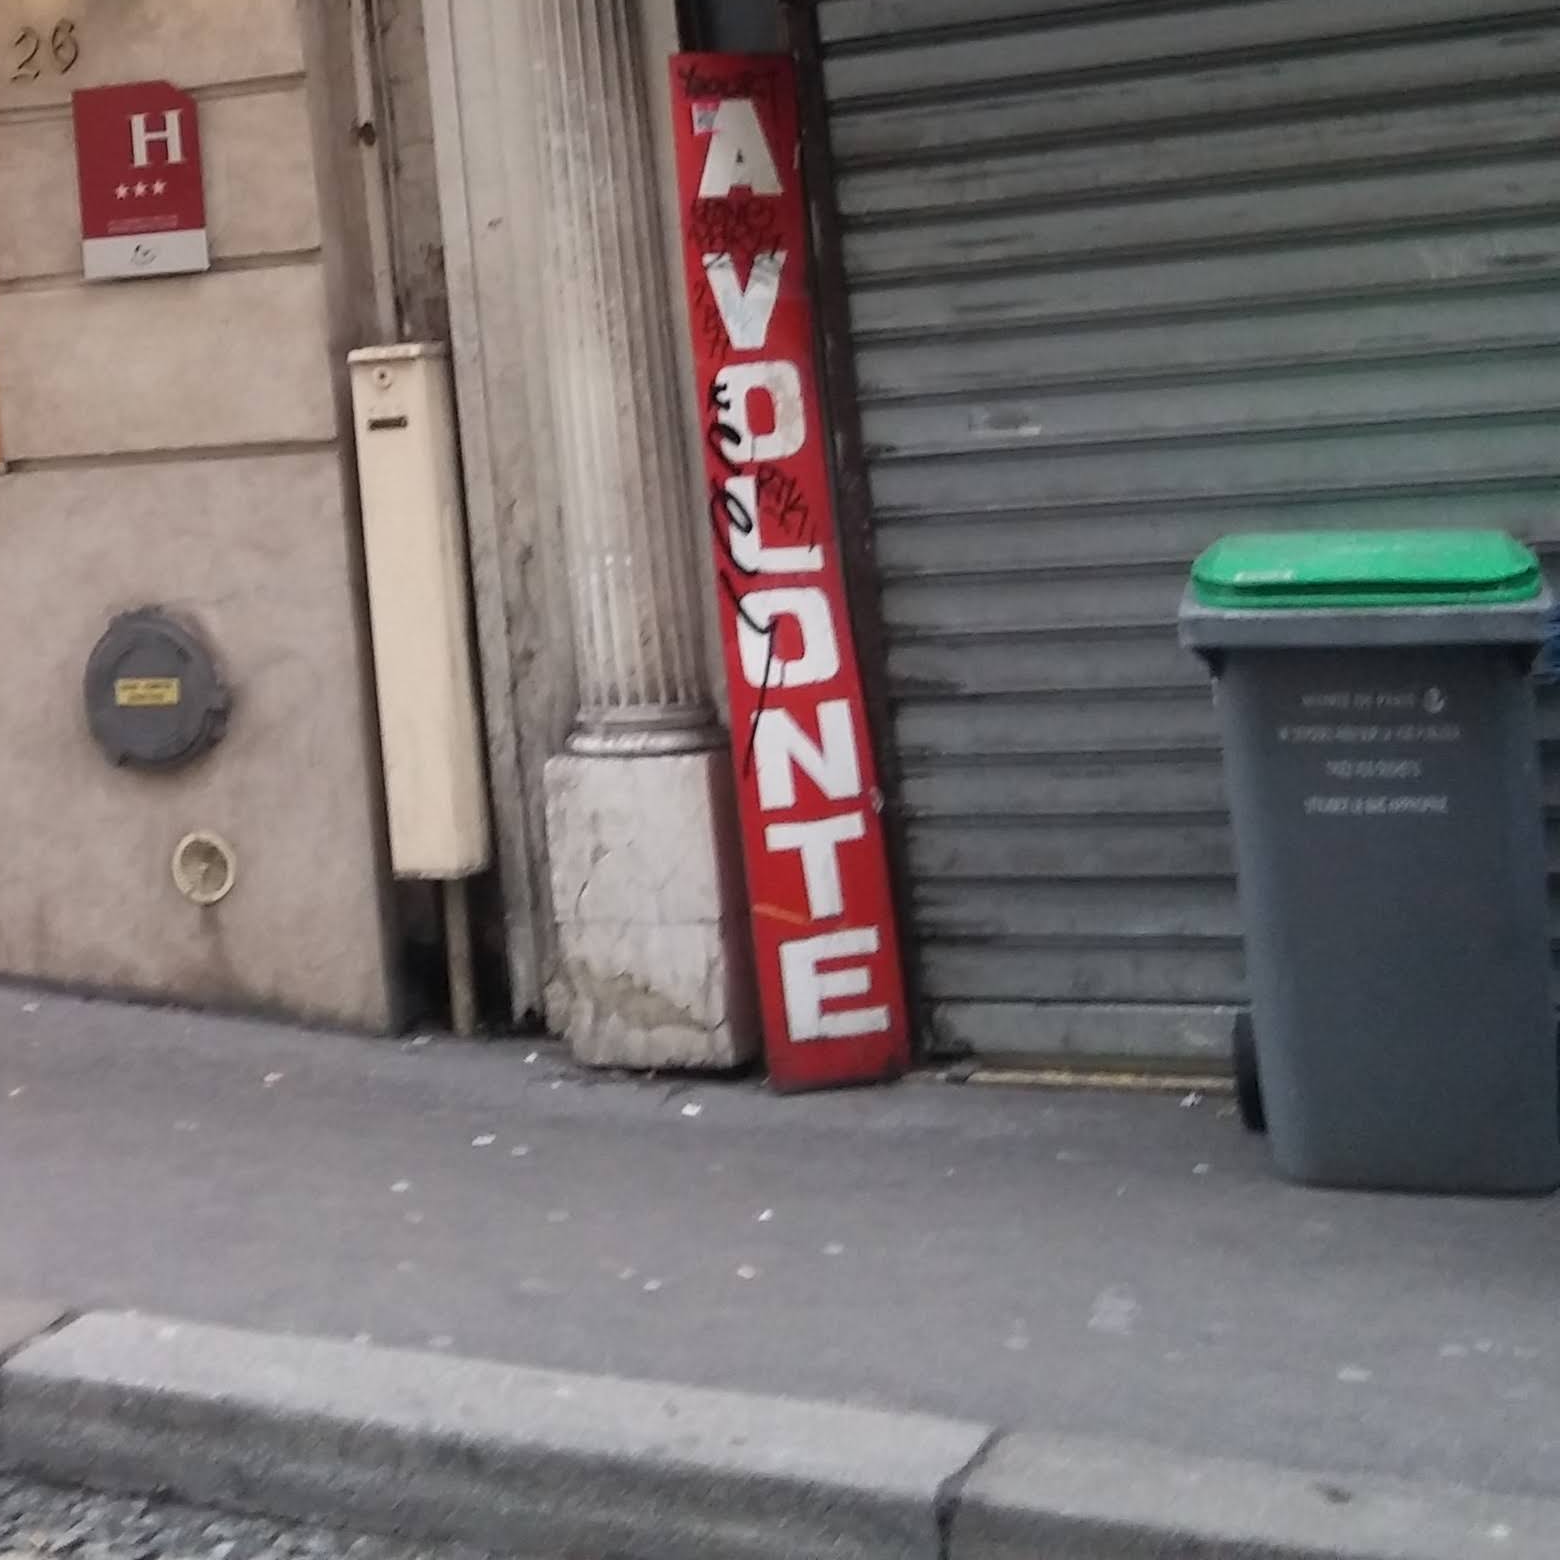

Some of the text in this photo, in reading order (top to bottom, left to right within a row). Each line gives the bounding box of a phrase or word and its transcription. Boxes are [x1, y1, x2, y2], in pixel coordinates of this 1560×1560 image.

[10, 17, 80, 84] 26
[126, 107, 187, 169] H
[696, 96, 786, 198] A
[701, 249, 892, 1043] VOLONTE
